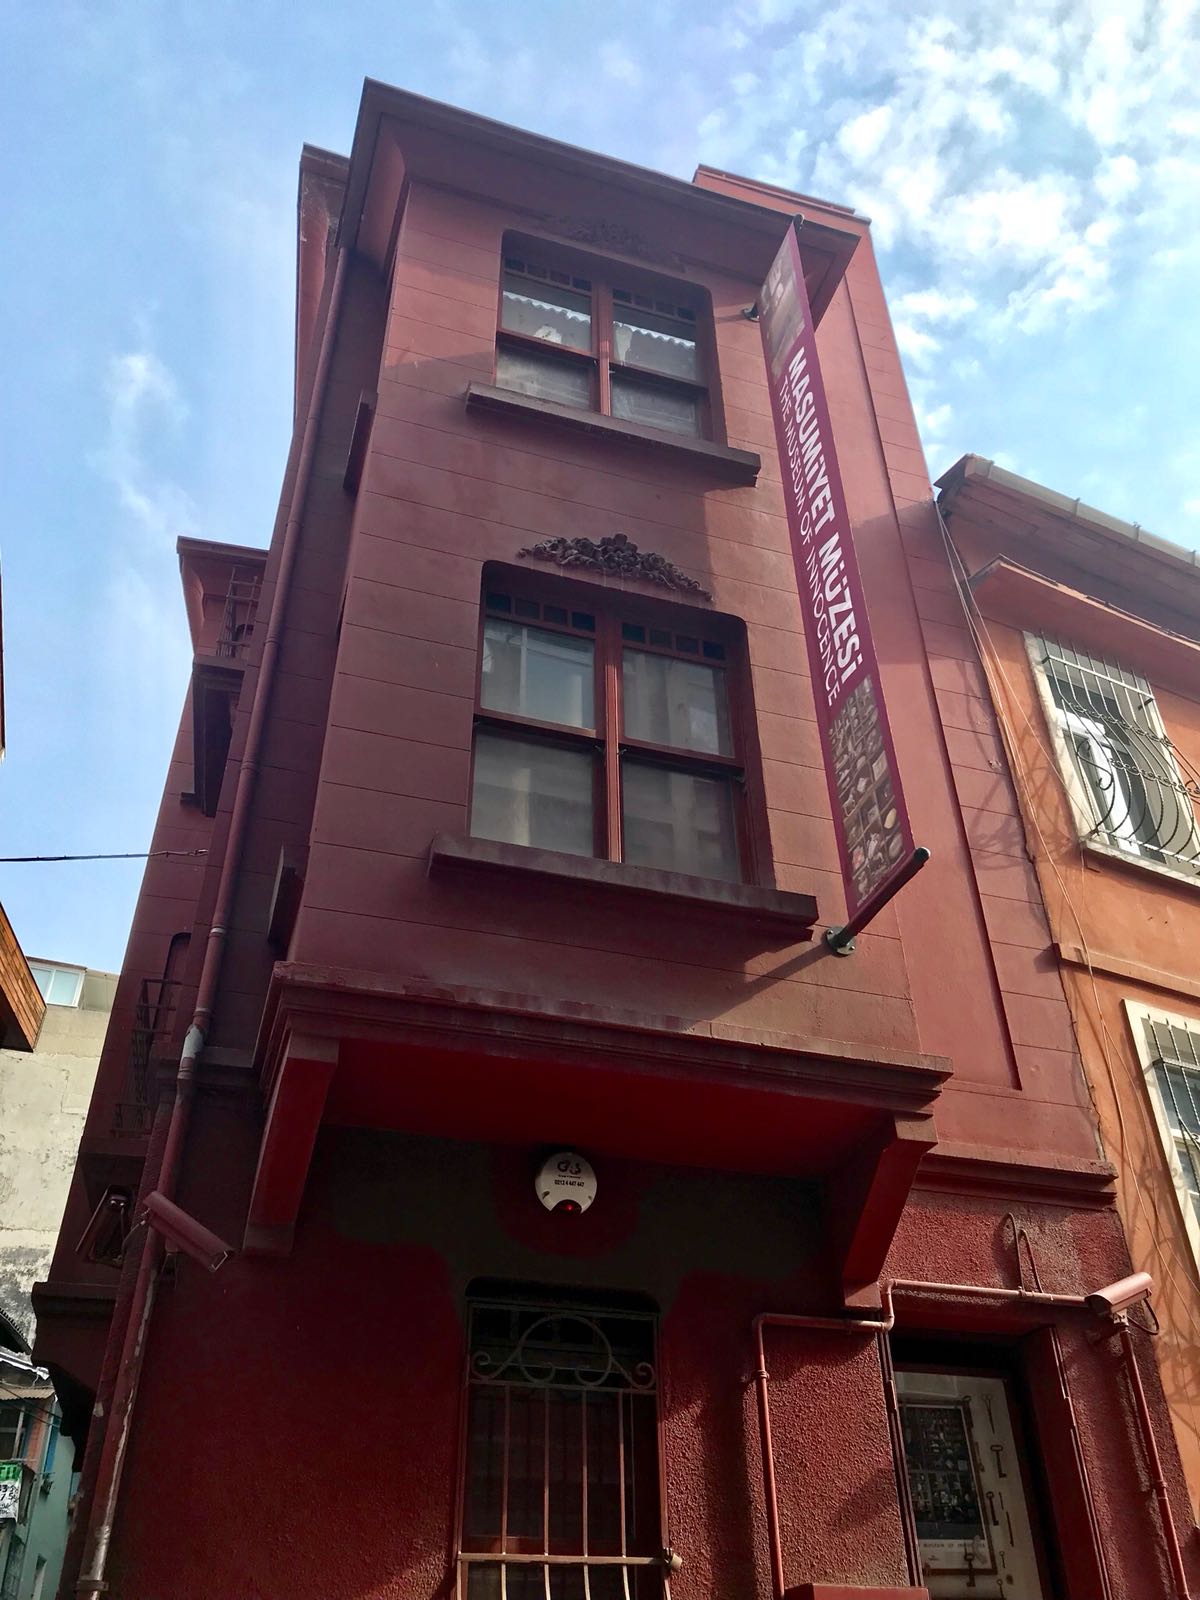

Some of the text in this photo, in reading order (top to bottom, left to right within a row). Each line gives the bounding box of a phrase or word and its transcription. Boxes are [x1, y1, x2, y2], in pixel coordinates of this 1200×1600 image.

[779, 375, 840, 707] THE MUSEUM OF INNOCENCE
[788, 346, 863, 685] MASUMİYET MÜZESİ
